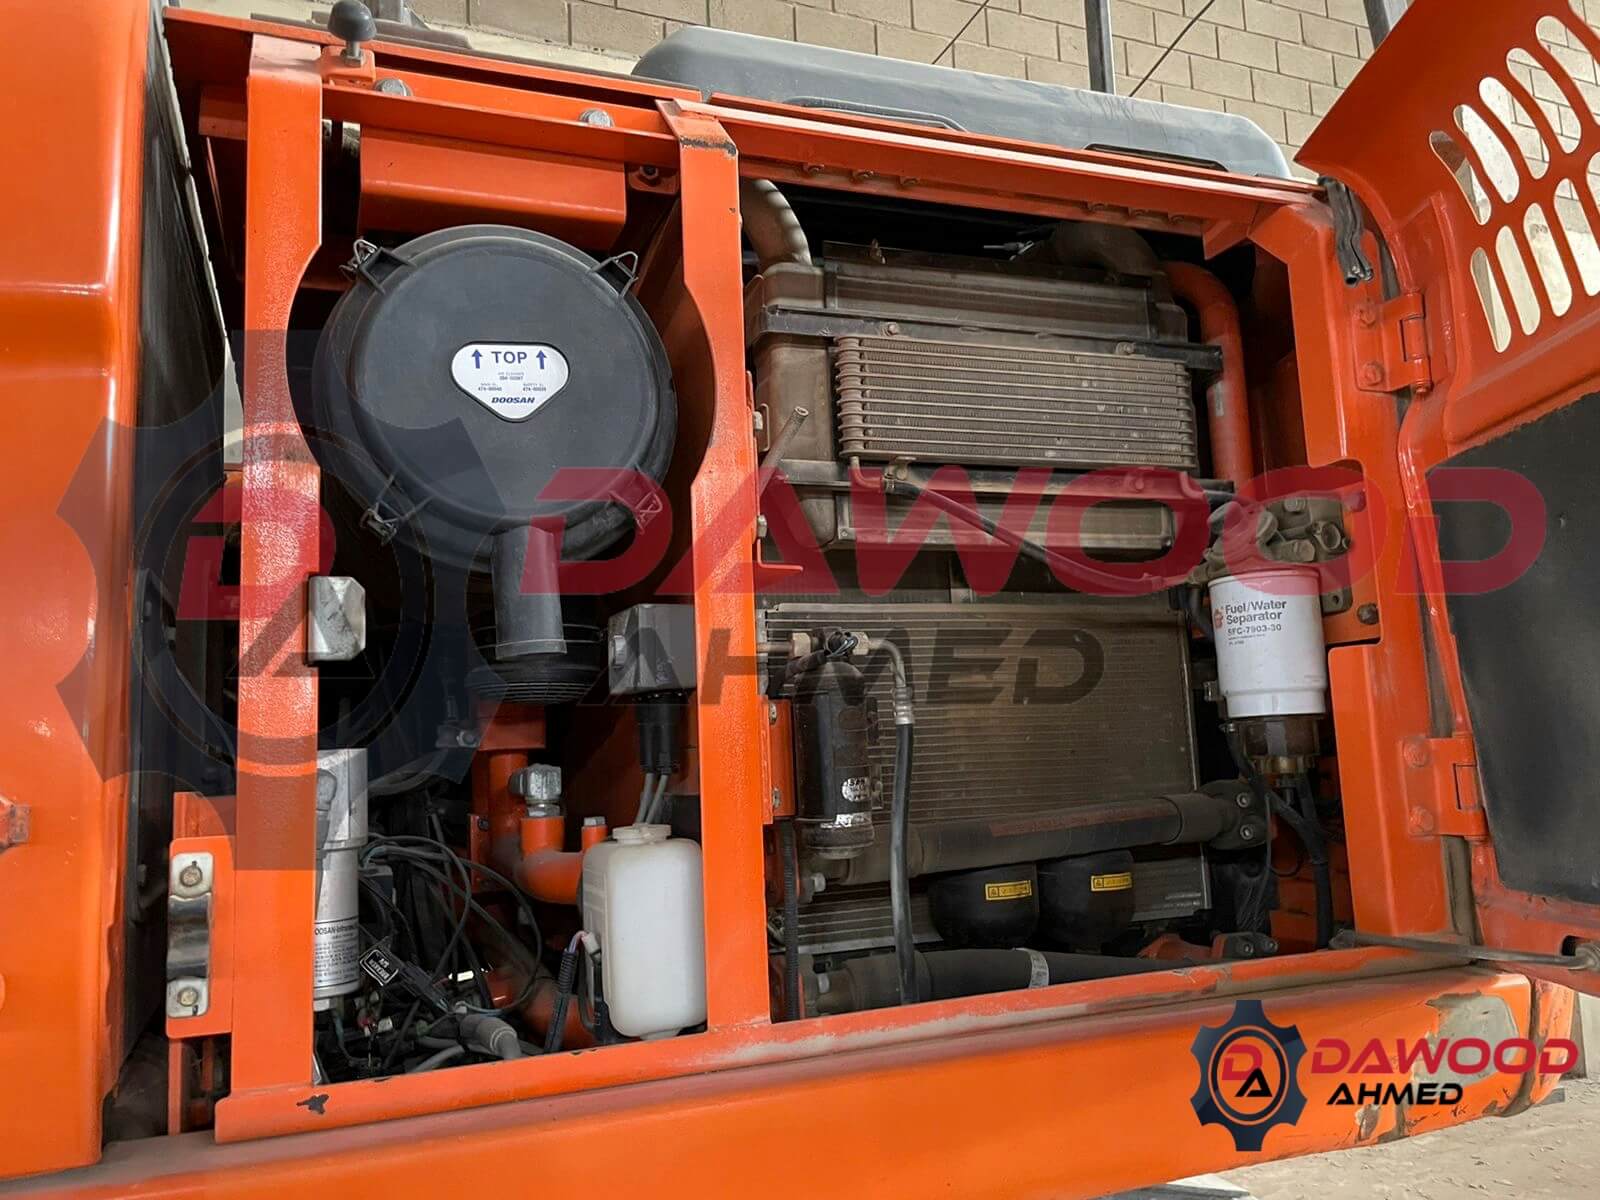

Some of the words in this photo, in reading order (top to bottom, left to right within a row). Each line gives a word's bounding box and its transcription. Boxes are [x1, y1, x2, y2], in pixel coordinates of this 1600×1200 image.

[491, 351, 527, 364] TOP
[1225, 600, 1287, 615] Fuel/Water
[1226, 611, 1283, 626] Separator
